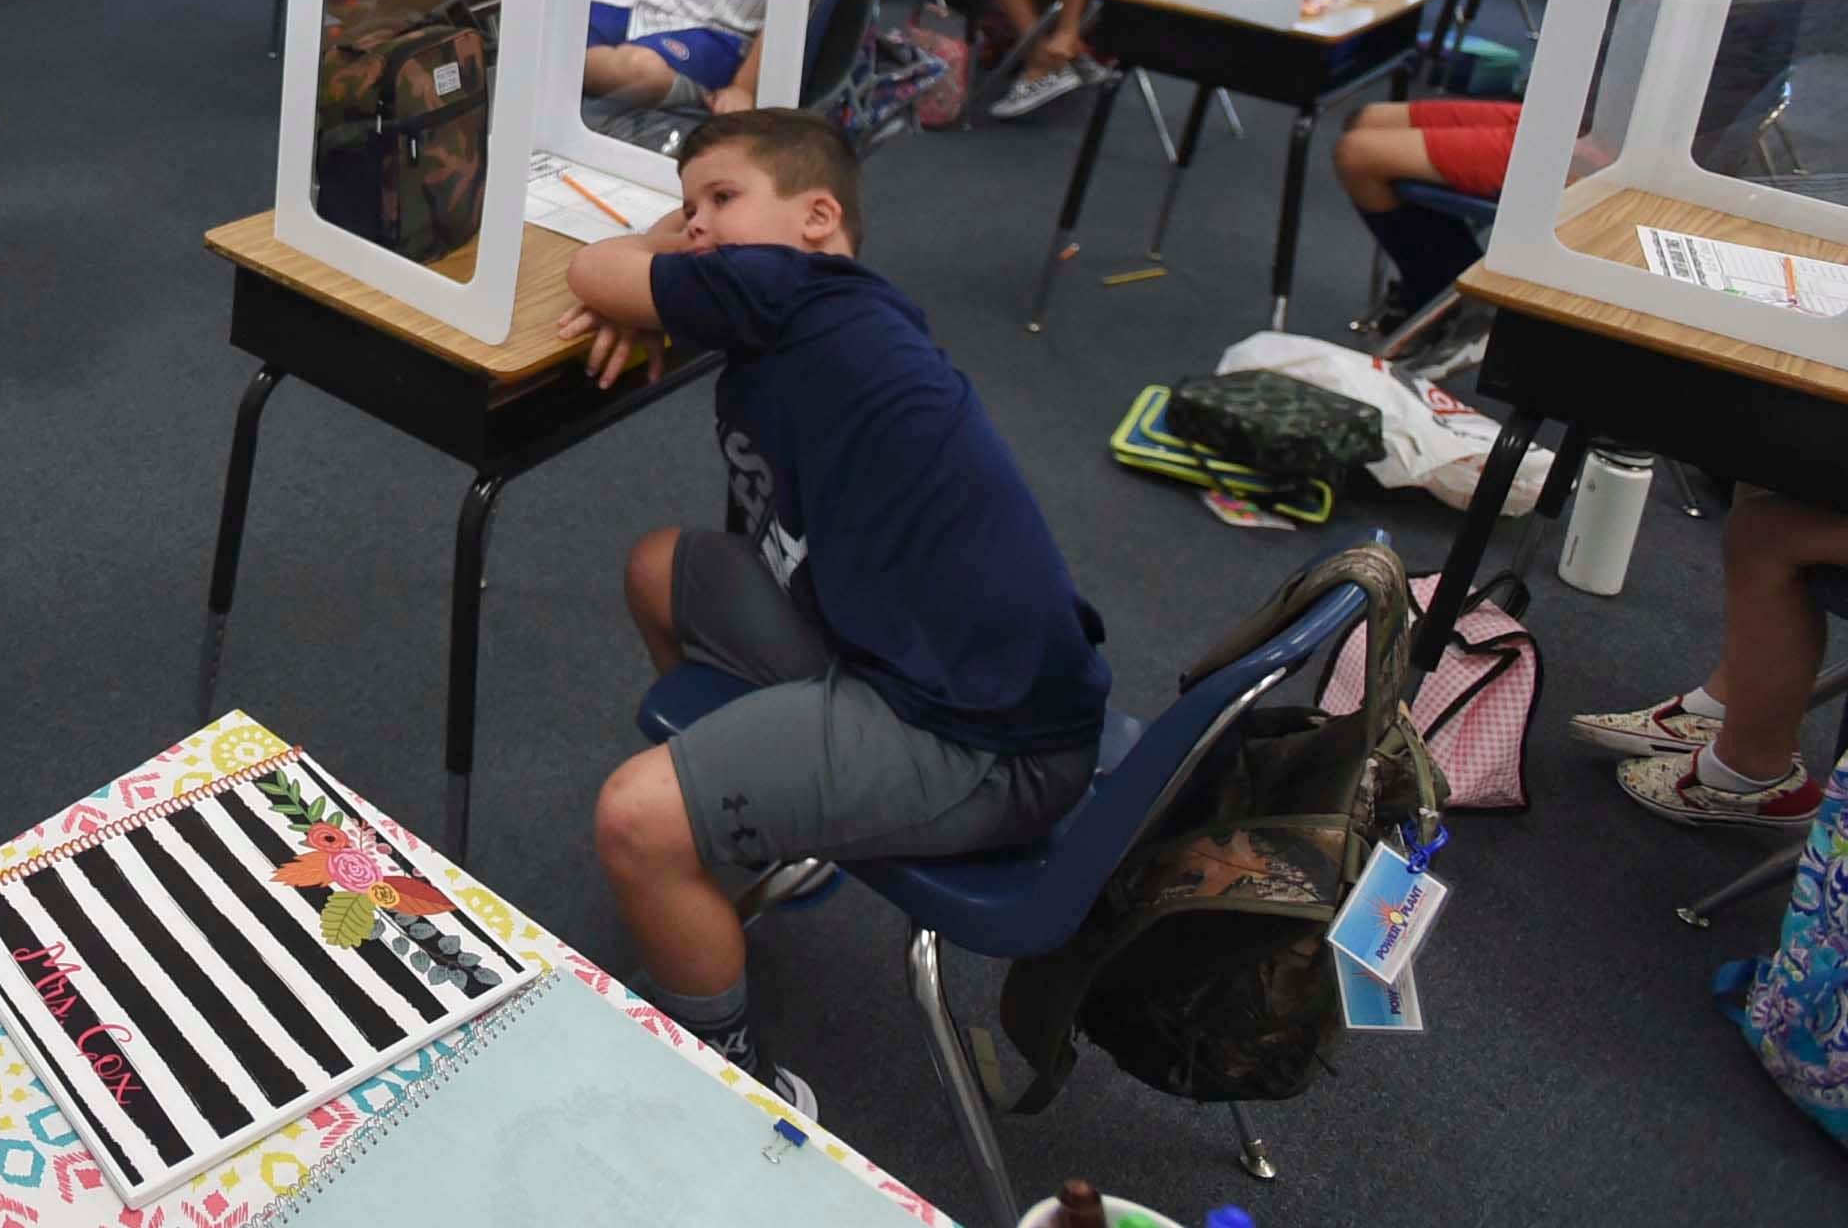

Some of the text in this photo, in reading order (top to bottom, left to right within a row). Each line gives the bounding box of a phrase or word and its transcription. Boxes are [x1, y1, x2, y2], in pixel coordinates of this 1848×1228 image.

[1375, 924, 1401, 961] POWER
[1400, 884, 1424, 918] PLANT
[12, 940, 143, 1105] Mrs. Cox
